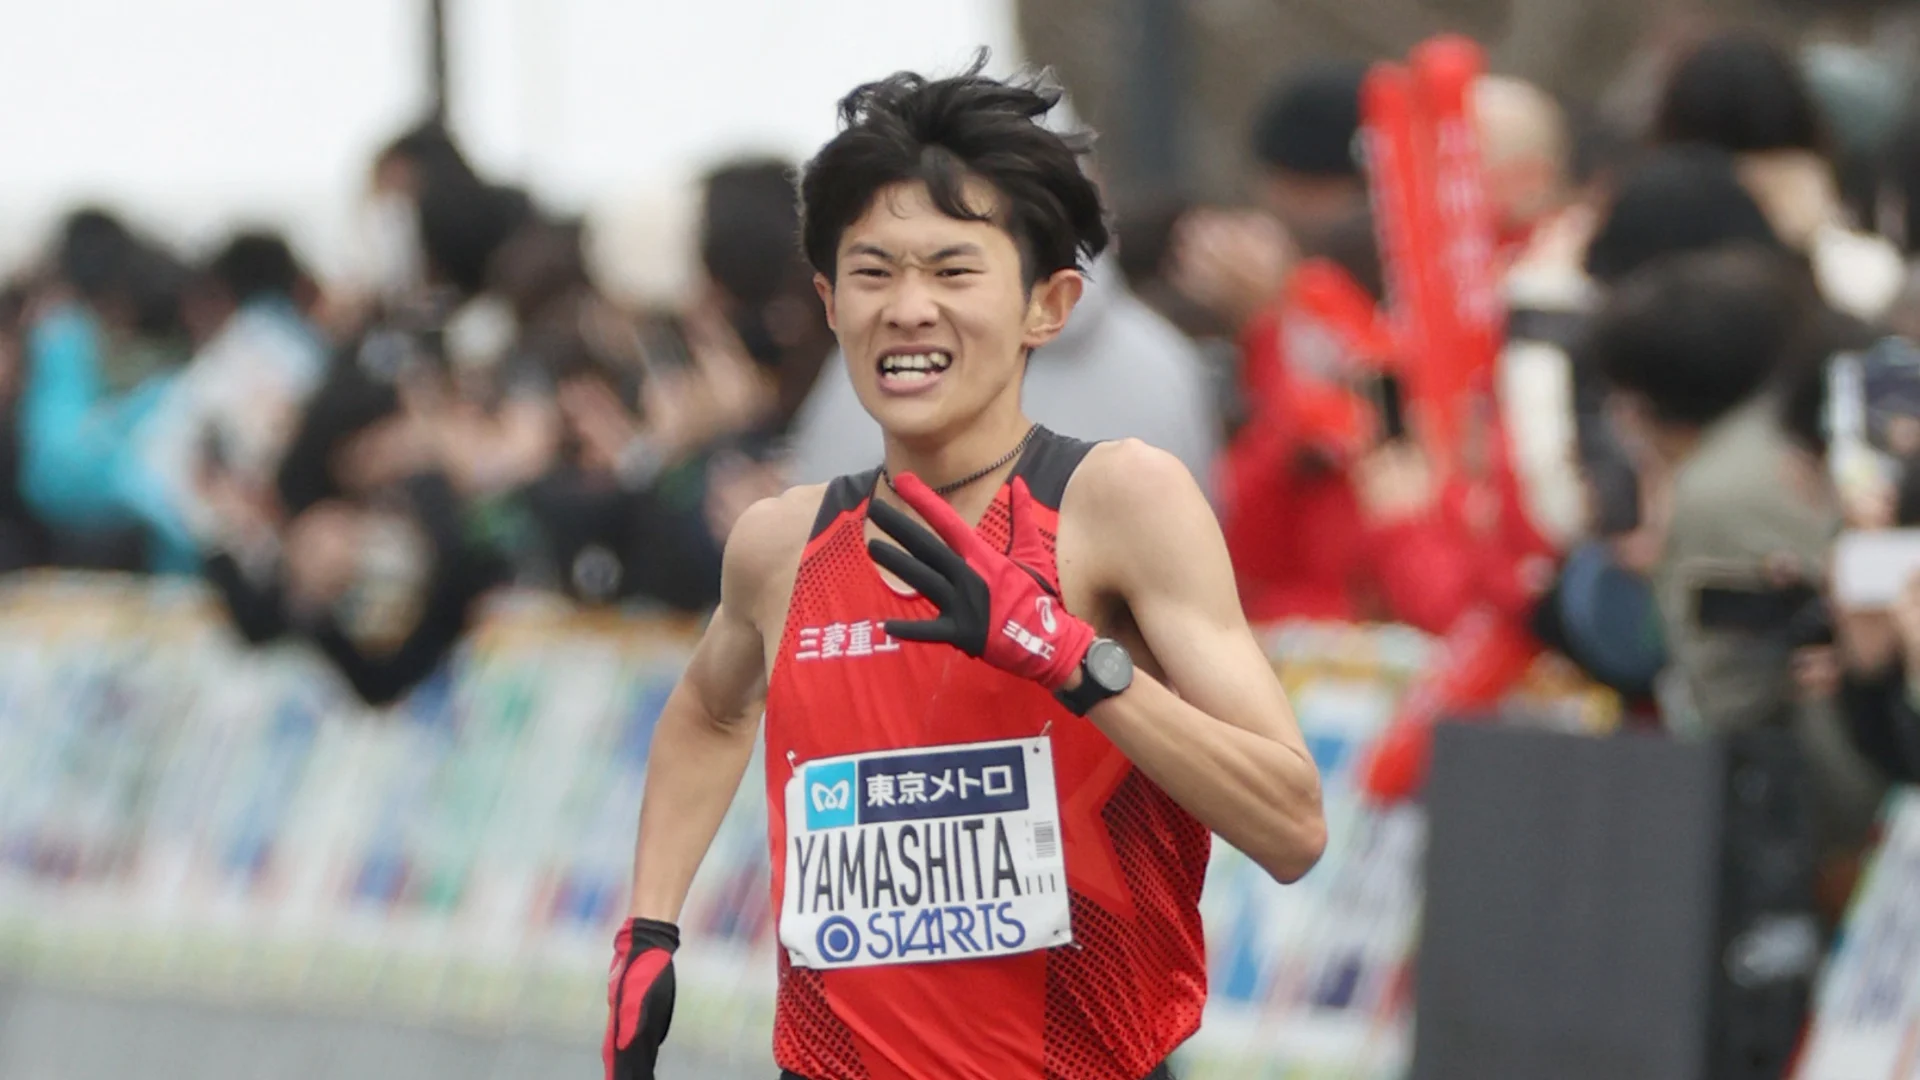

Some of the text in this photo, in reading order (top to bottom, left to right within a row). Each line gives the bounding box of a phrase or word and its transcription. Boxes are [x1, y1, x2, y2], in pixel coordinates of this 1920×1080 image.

[796, 620, 900, 659] 三菱重工
[1002, 619, 1055, 660] 三工
[866, 765, 1013, 807] 東京メトロ
[795, 817, 1022, 914] YAMASHITA
